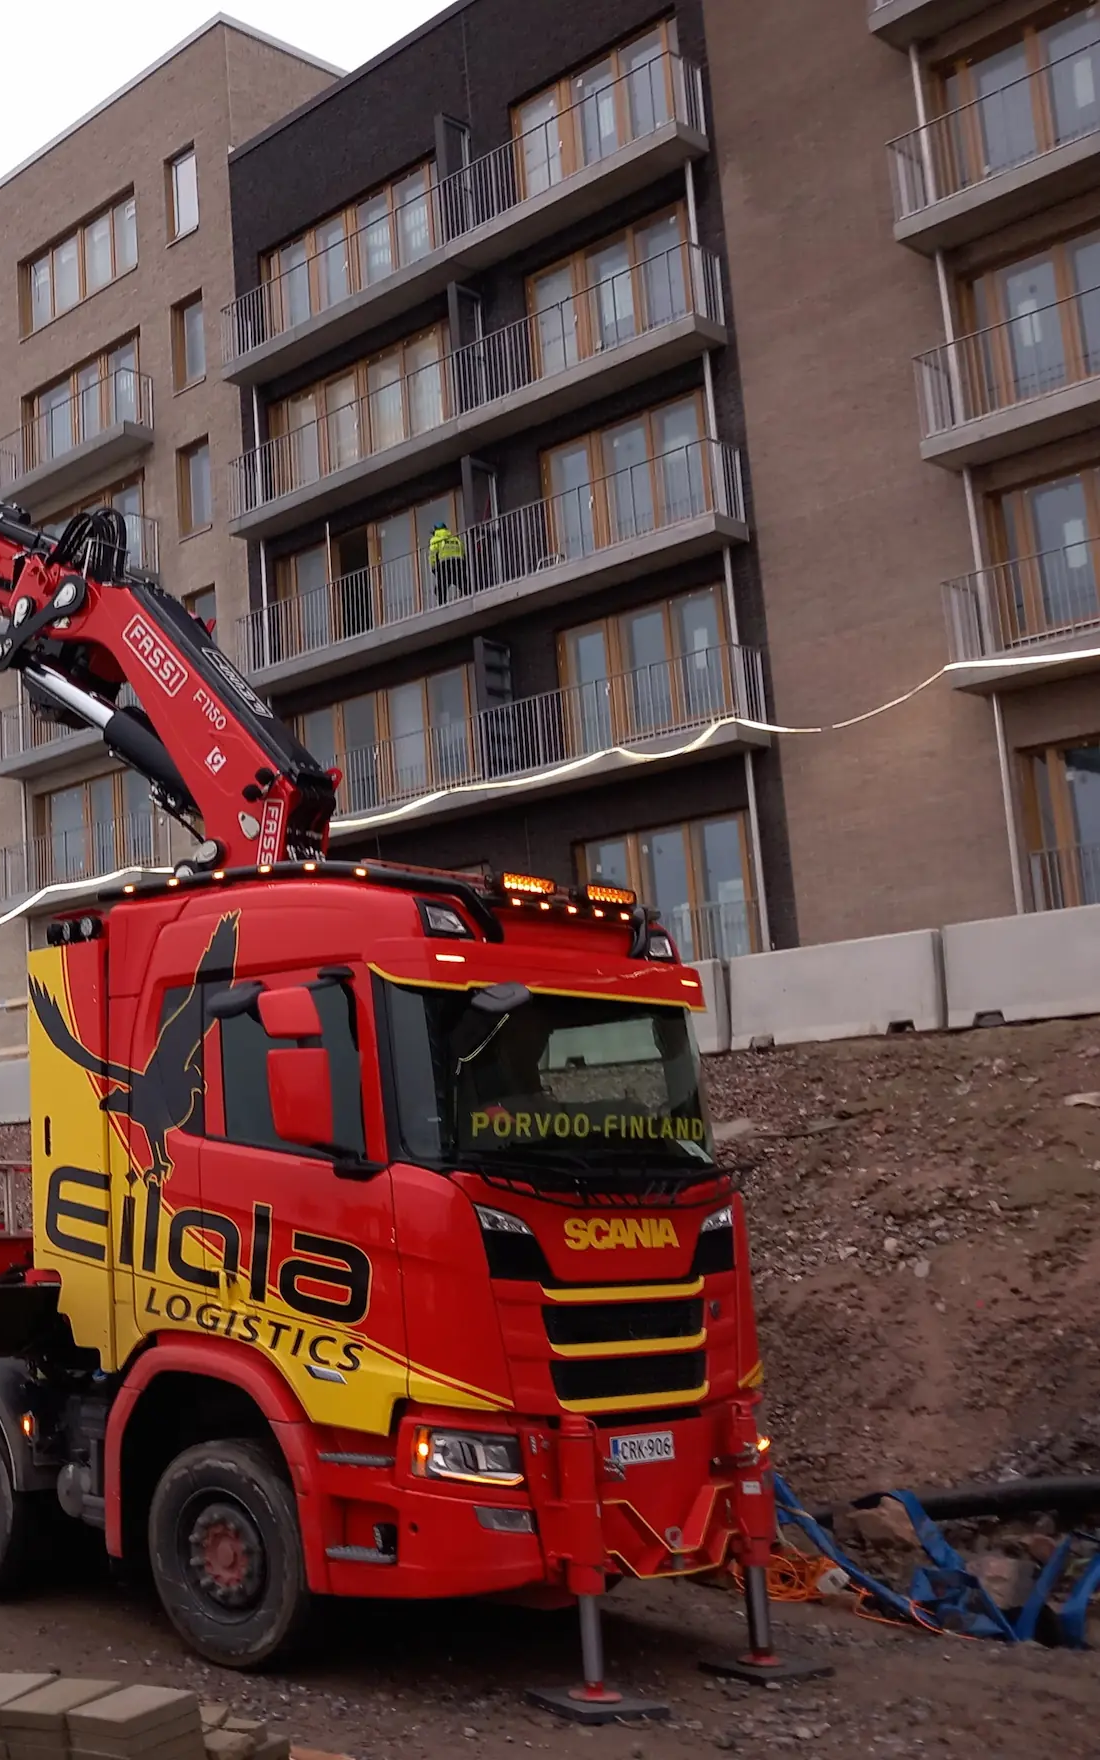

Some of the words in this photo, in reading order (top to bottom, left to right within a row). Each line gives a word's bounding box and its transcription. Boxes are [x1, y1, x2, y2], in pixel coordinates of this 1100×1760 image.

[130, 624, 181, 688] FASSI
[193, 688, 227, 730] F1150
[261, 805, 279, 865] FASS
[471, 1111, 704, 1141] PORVOO-FINLAND
[564, 1218, 680, 1251] SCANIA
[146, 1287, 365, 1371] LOGISTICS
[620, 1437, 671, 1460] CRK-906
